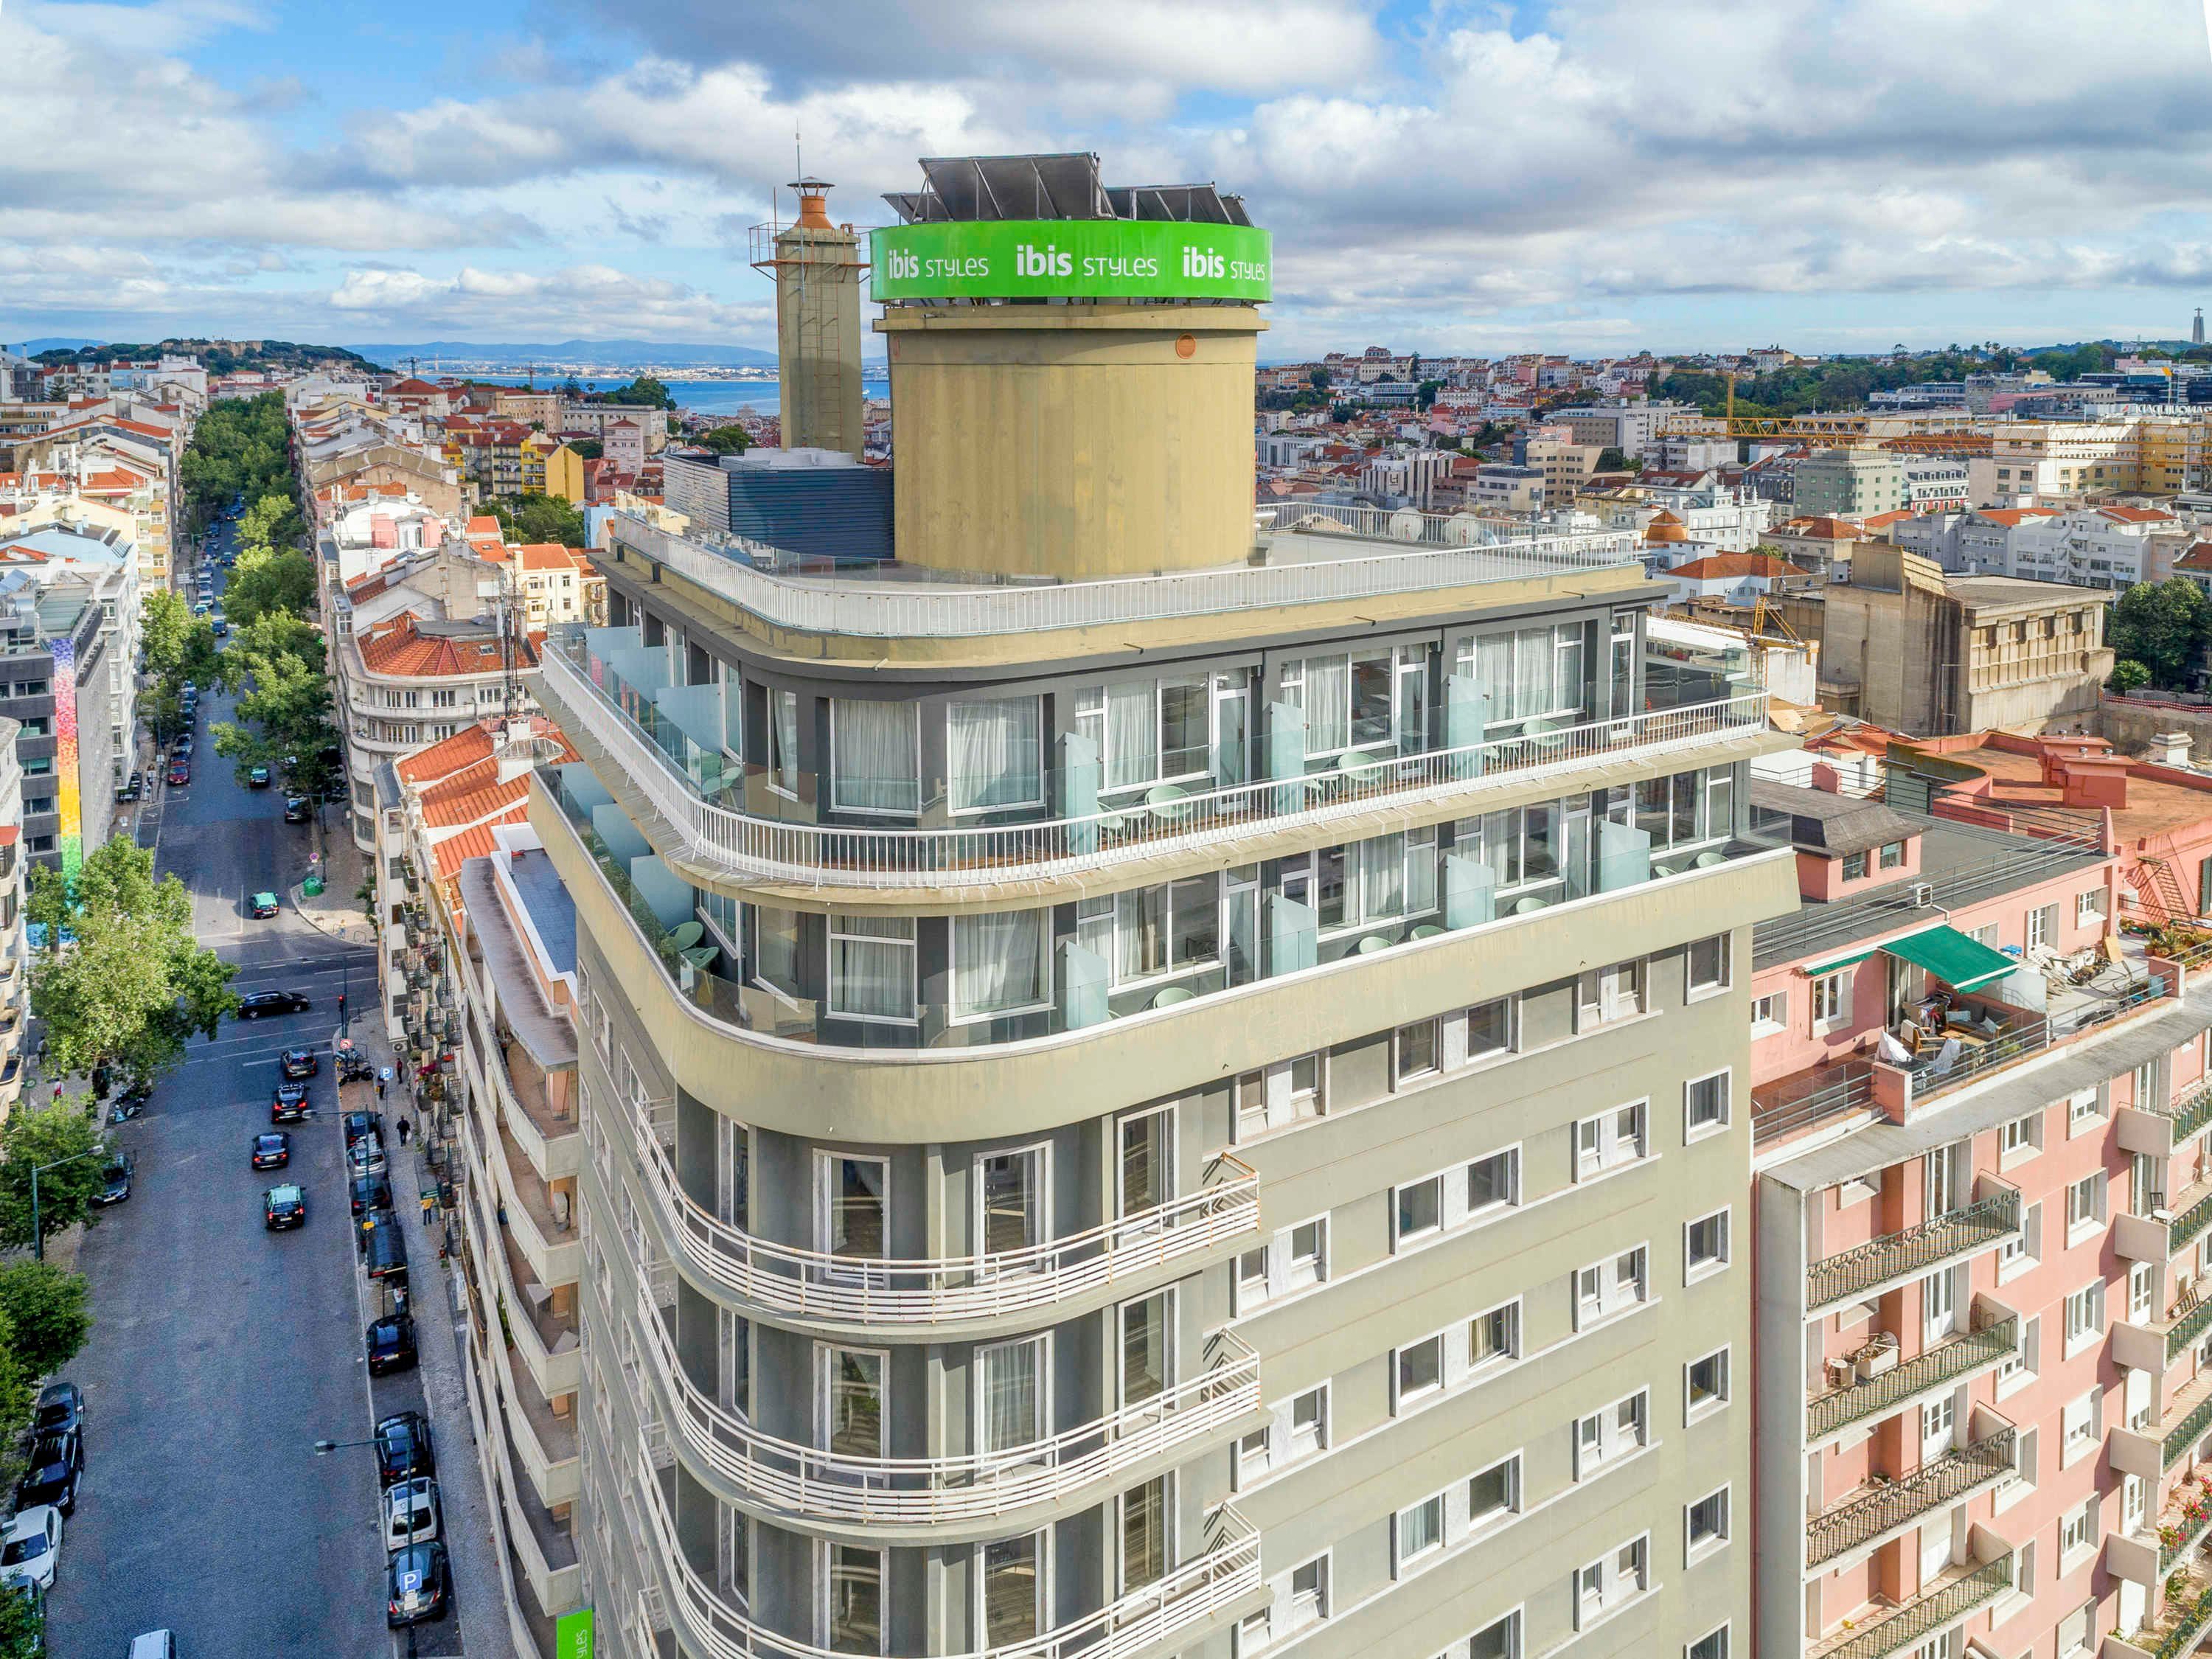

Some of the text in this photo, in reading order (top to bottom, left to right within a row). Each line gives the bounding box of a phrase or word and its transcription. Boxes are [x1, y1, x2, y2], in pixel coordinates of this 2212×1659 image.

[888, 248, 919, 279] ibis
[1017, 245, 1073, 276] ibis
[1183, 246, 1225, 278] ibis
[383, 1068, 390, 1078] P
[404, 1573, 417, 1590] P
